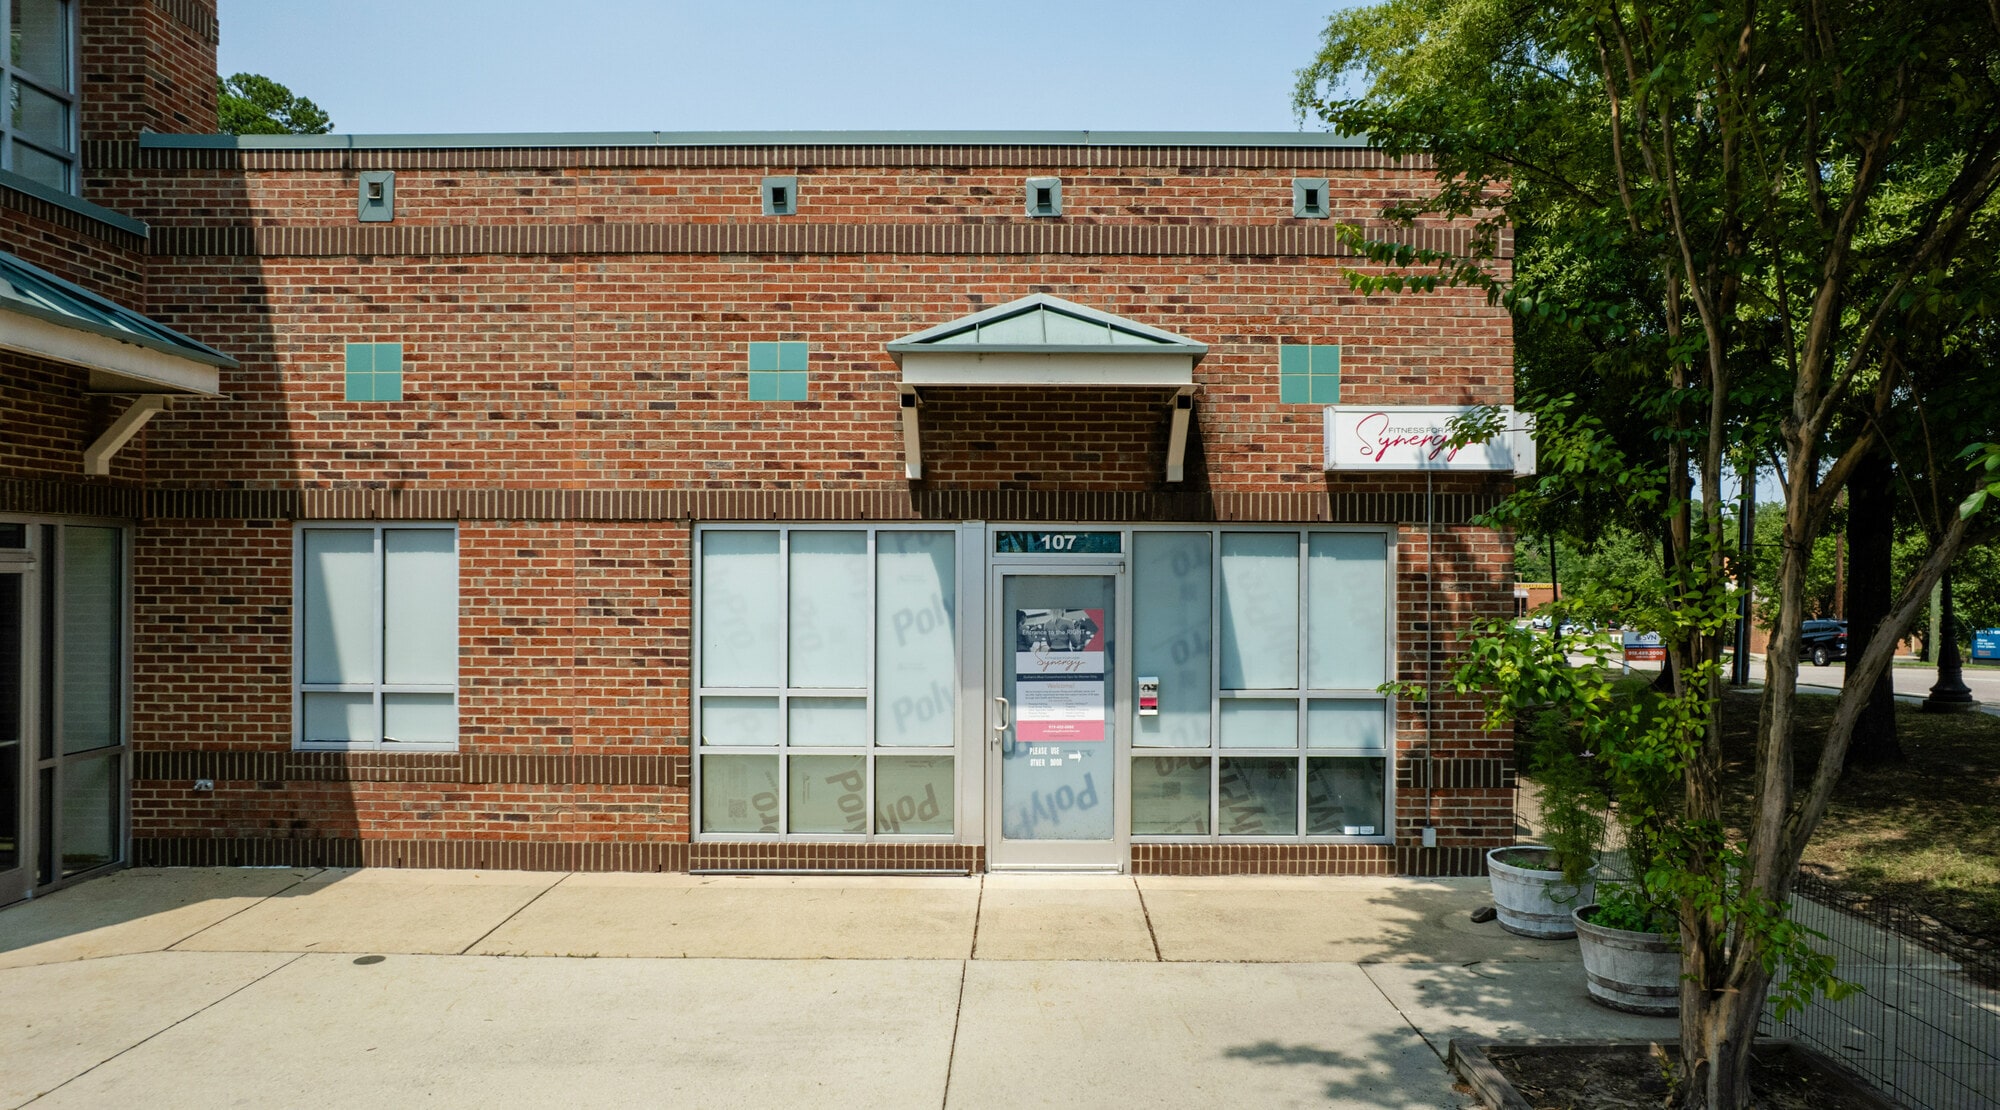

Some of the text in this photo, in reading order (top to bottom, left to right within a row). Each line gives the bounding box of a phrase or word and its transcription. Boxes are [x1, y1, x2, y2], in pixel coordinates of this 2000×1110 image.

[1388, 426, 1425, 434] FITNESS
[1426, 426, 1444, 434] FOR
[1041, 534, 1077, 550] 107
[1035, 646, 1086, 672] Synergy
[1029, 746, 1048, 755] PLEASE
[1050, 746, 1060, 755] USE
[1030, 758, 1063, 767] OTHER DOOR
